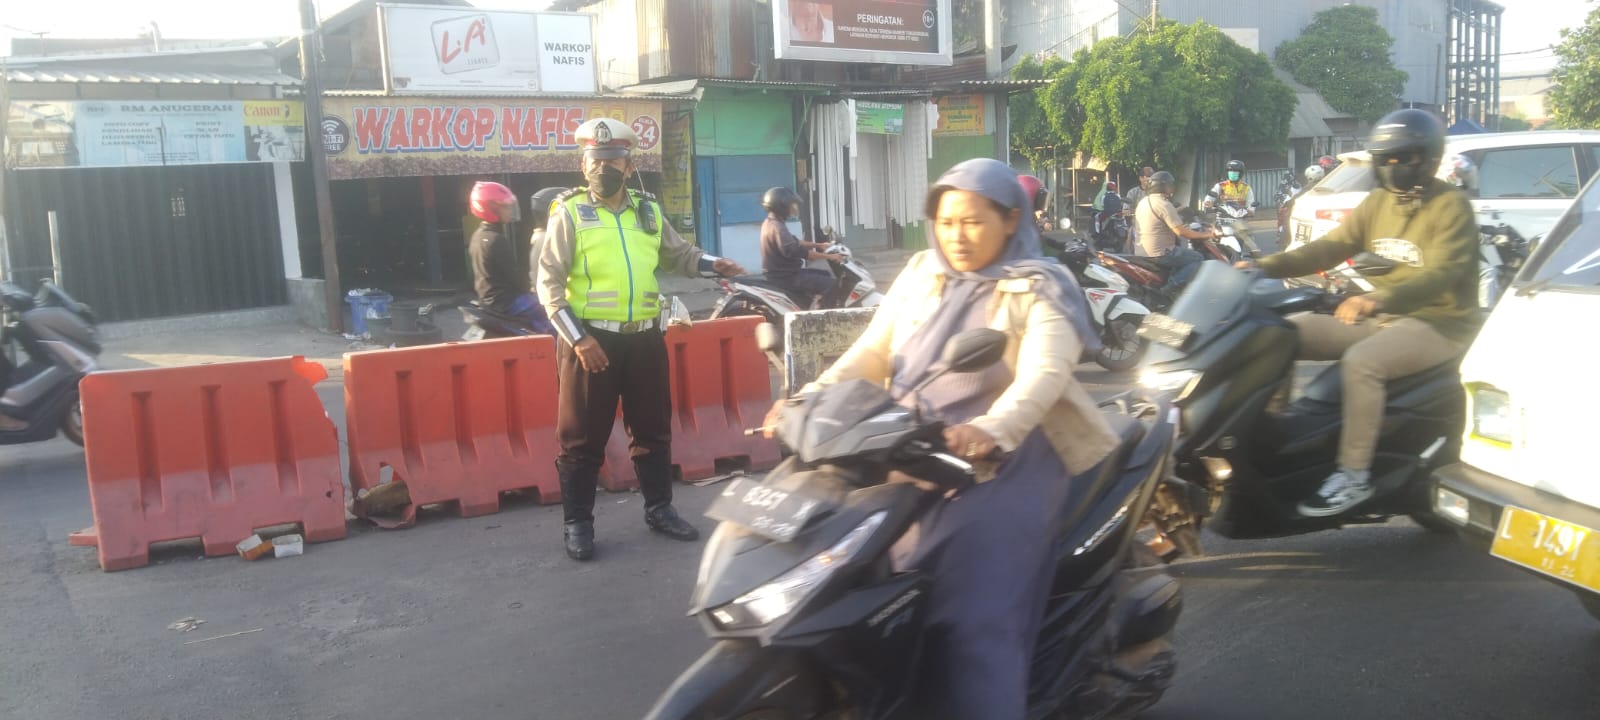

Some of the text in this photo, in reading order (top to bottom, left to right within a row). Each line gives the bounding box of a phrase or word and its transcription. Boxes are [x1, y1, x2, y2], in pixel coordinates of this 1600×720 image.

[856, 13, 905, 26] PERINGATAN:
[544, 42, 592, 53] WARKOP
[552, 55, 585, 66] NAFIS
[243, 104, 281, 117] Canon
[353, 105, 495, 153] WARKOP
[501, 105, 585, 151] NAFIS
[634, 122, 656, 142] 24
[722, 479, 743, 496] L
[1500, 509, 1514, 539] L
